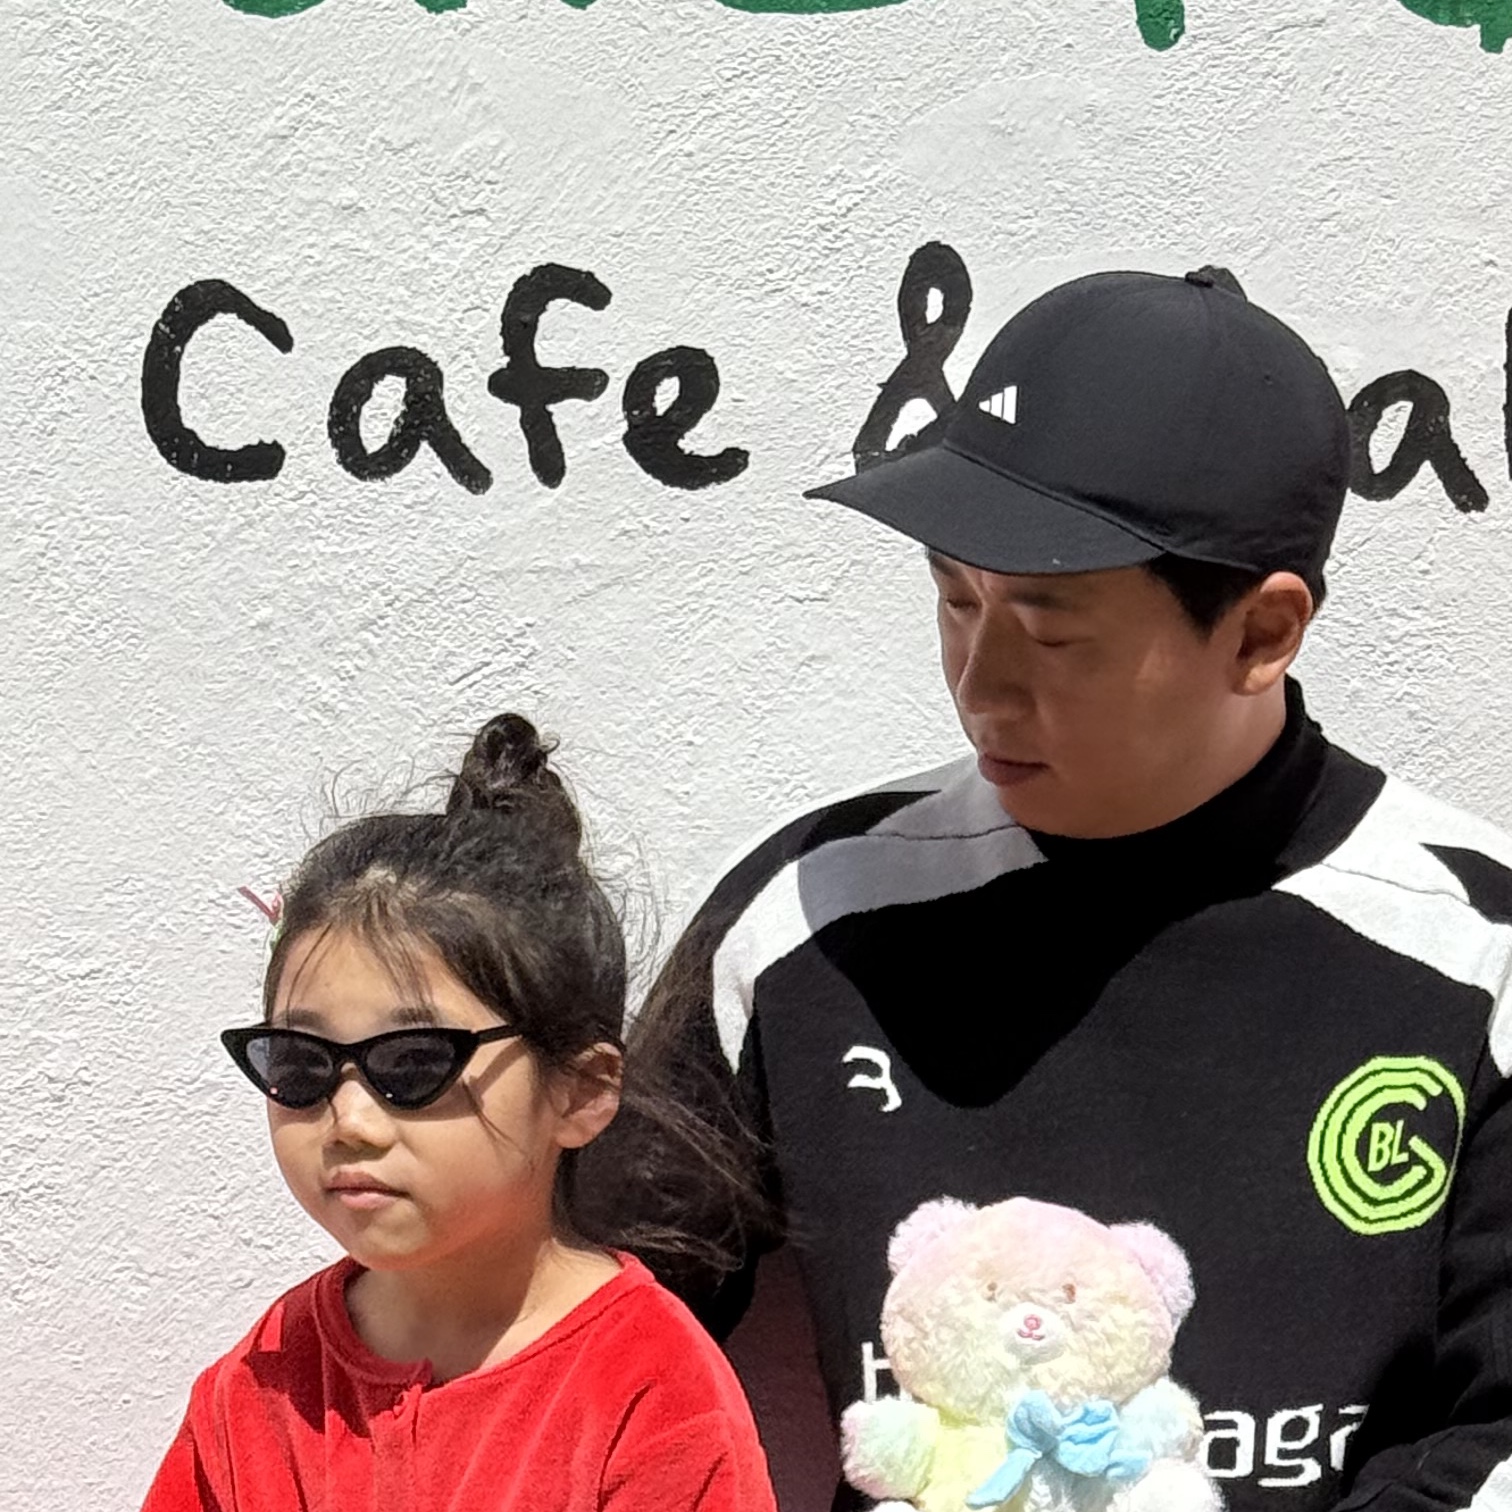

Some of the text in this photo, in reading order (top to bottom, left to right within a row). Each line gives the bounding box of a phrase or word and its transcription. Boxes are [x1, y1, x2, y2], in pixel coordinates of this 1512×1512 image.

[141, 263, 749, 495] Cafe
[853, 241, 973, 475] &
[1367, 1119, 1409, 1172] BL
